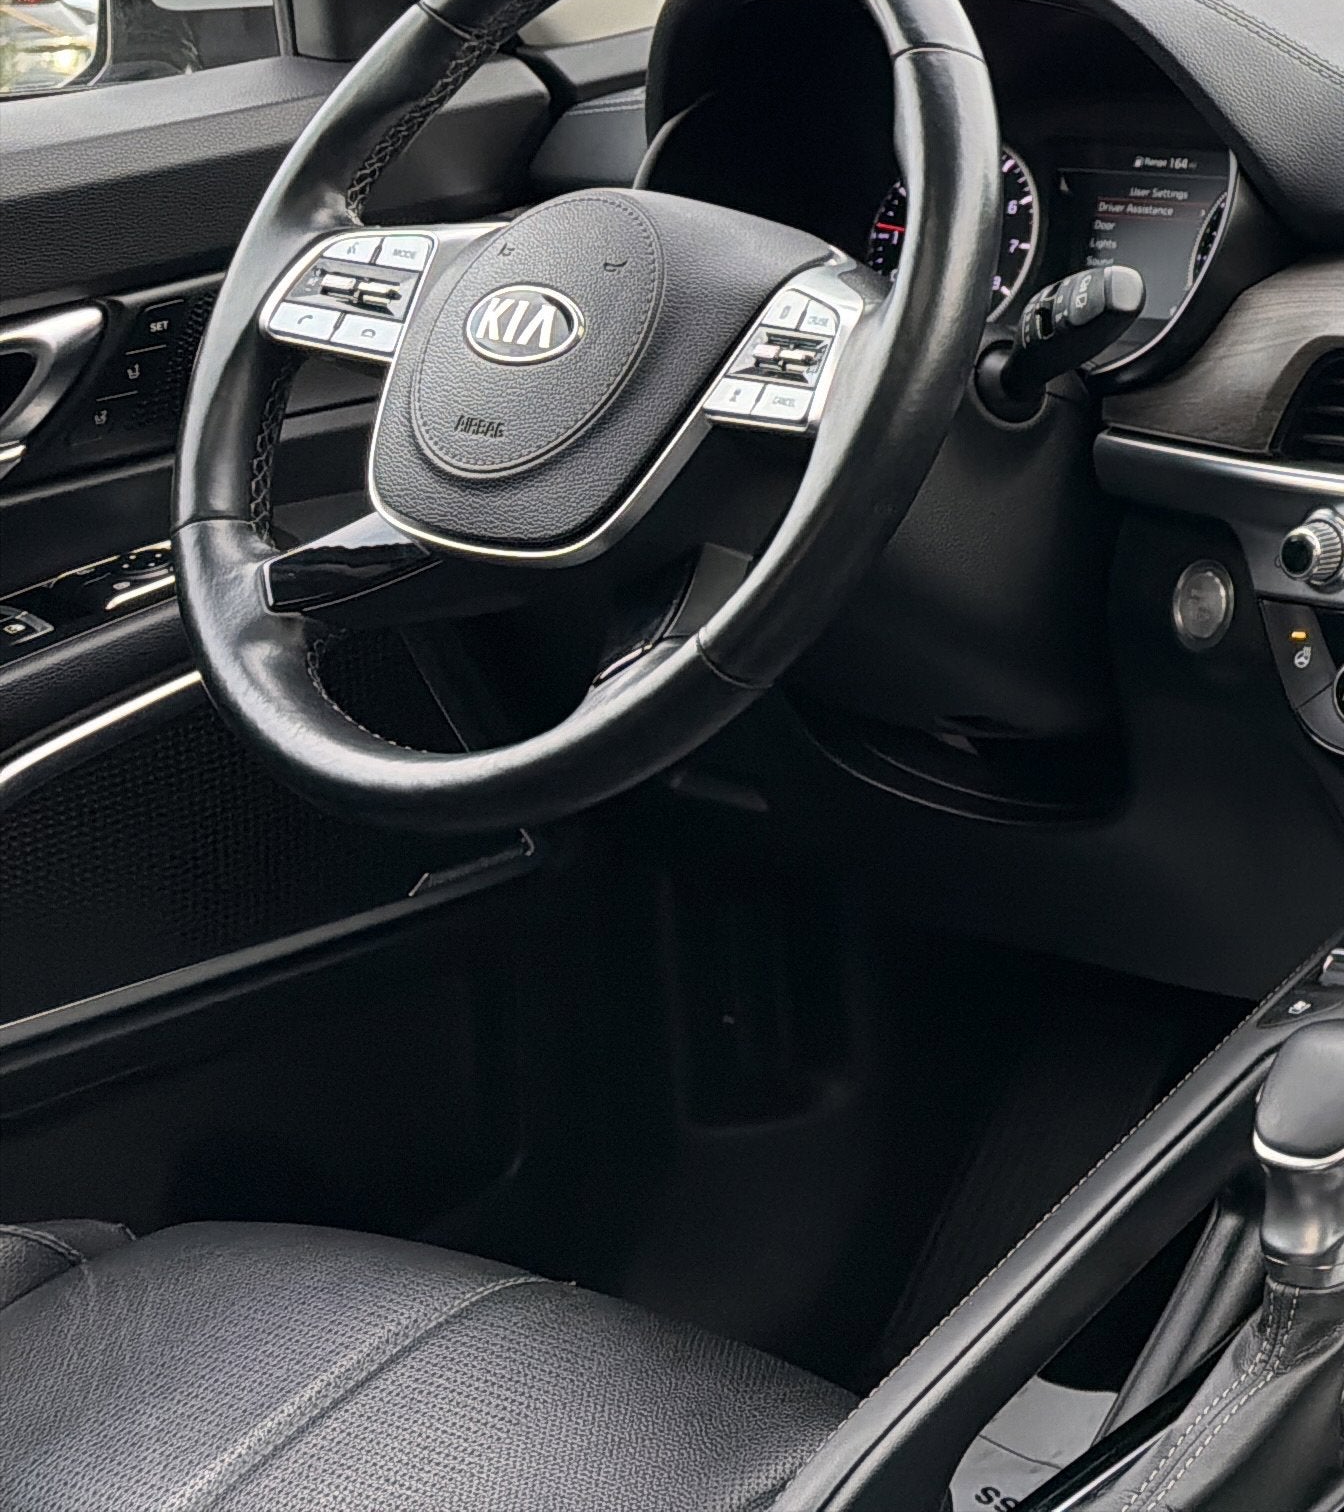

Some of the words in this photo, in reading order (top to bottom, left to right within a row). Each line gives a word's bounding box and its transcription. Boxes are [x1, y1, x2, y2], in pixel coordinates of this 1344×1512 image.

[1129, 187, 1151, 197] User
[1152, 188, 1189, 201] Settings
[1098, 201, 1125, 213] Driver
[1126, 202, 1174, 217] Assistance
[1094, 219, 1116, 231] Door
[1009, 238, 1019, 253] 7
[1089, 238, 1118, 250] Lights
[150, 320, 169, 333] SET
[476, 296, 557, 348] KIA
[453, 414, 504, 438] AIRBAG
